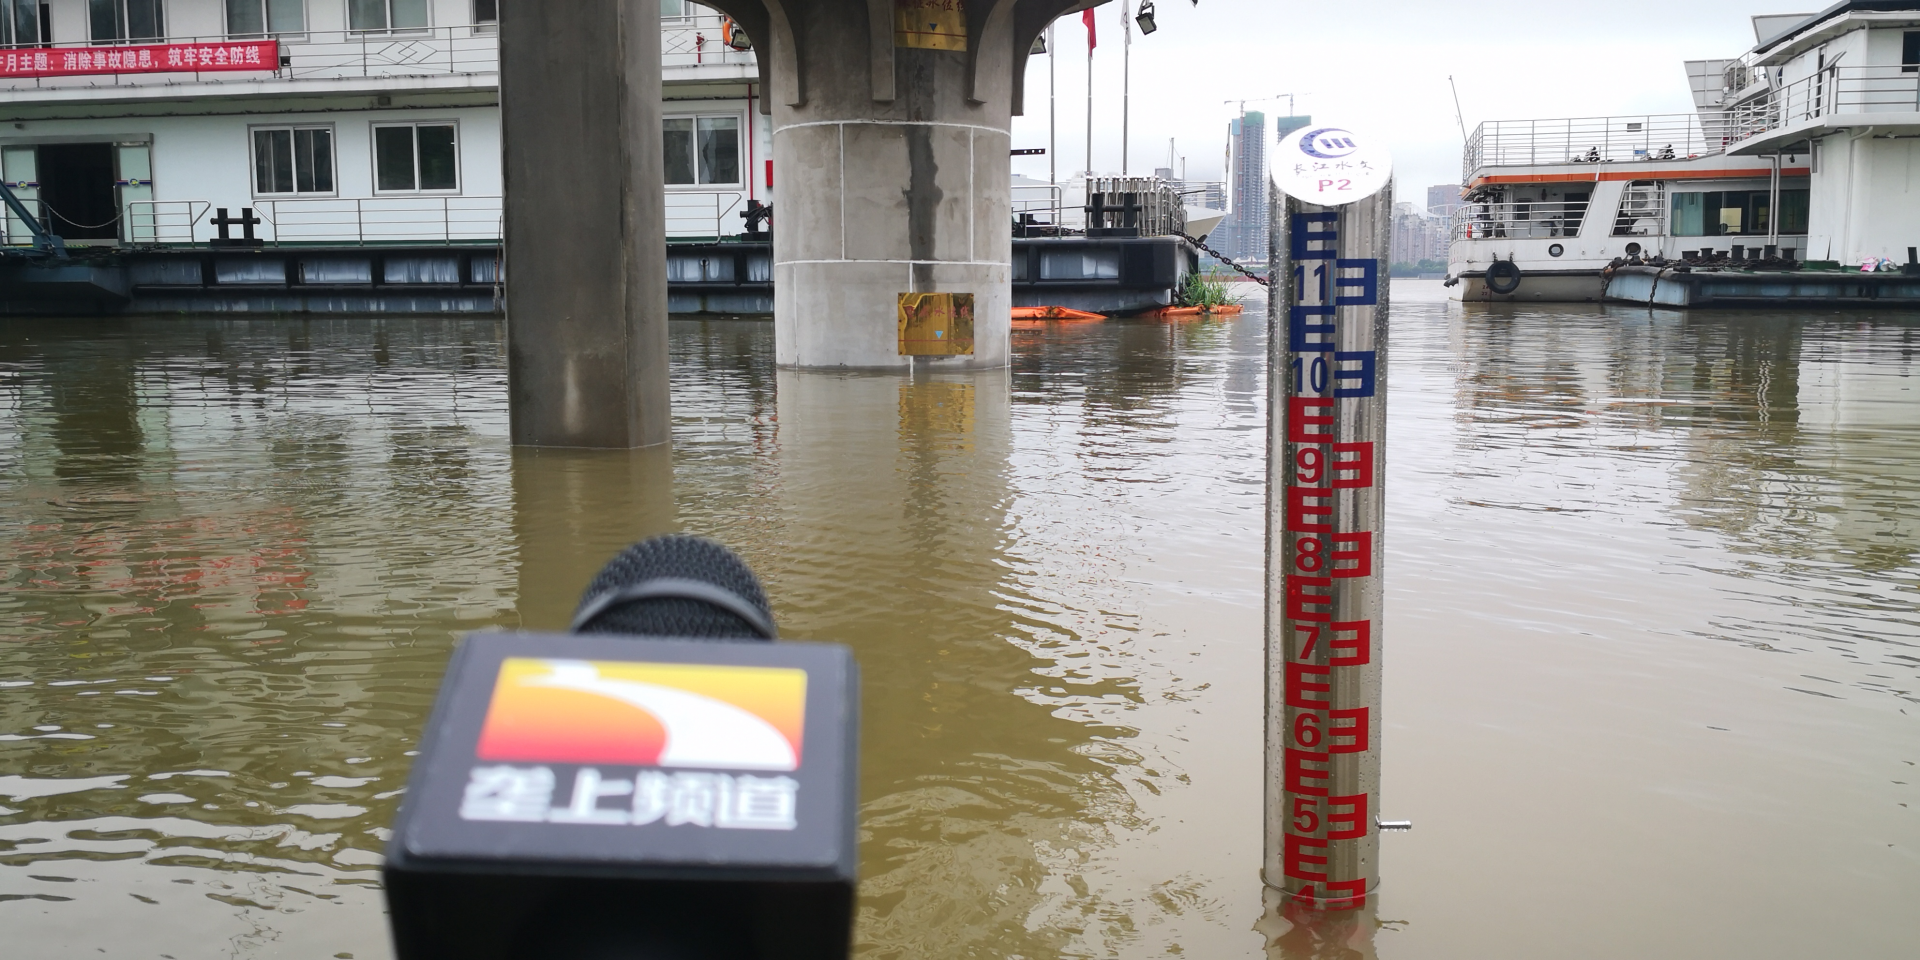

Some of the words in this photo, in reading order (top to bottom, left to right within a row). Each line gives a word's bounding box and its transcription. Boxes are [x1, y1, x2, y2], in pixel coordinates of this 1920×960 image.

[1293, 160, 1374, 176] 长江水文
[1318, 179, 1352, 192] P2
[1294, 264, 1326, 303] 11
[1292, 356, 1328, 393] 10
[1296, 447, 1324, 483] 9
[1295, 537, 1323, 572] 8
[1295, 624, 1320, 660] 7
[1294, 712, 1321, 748] 6
[459, 765, 800, 830] 垄上频道
[1293, 797, 1319, 833] 5
